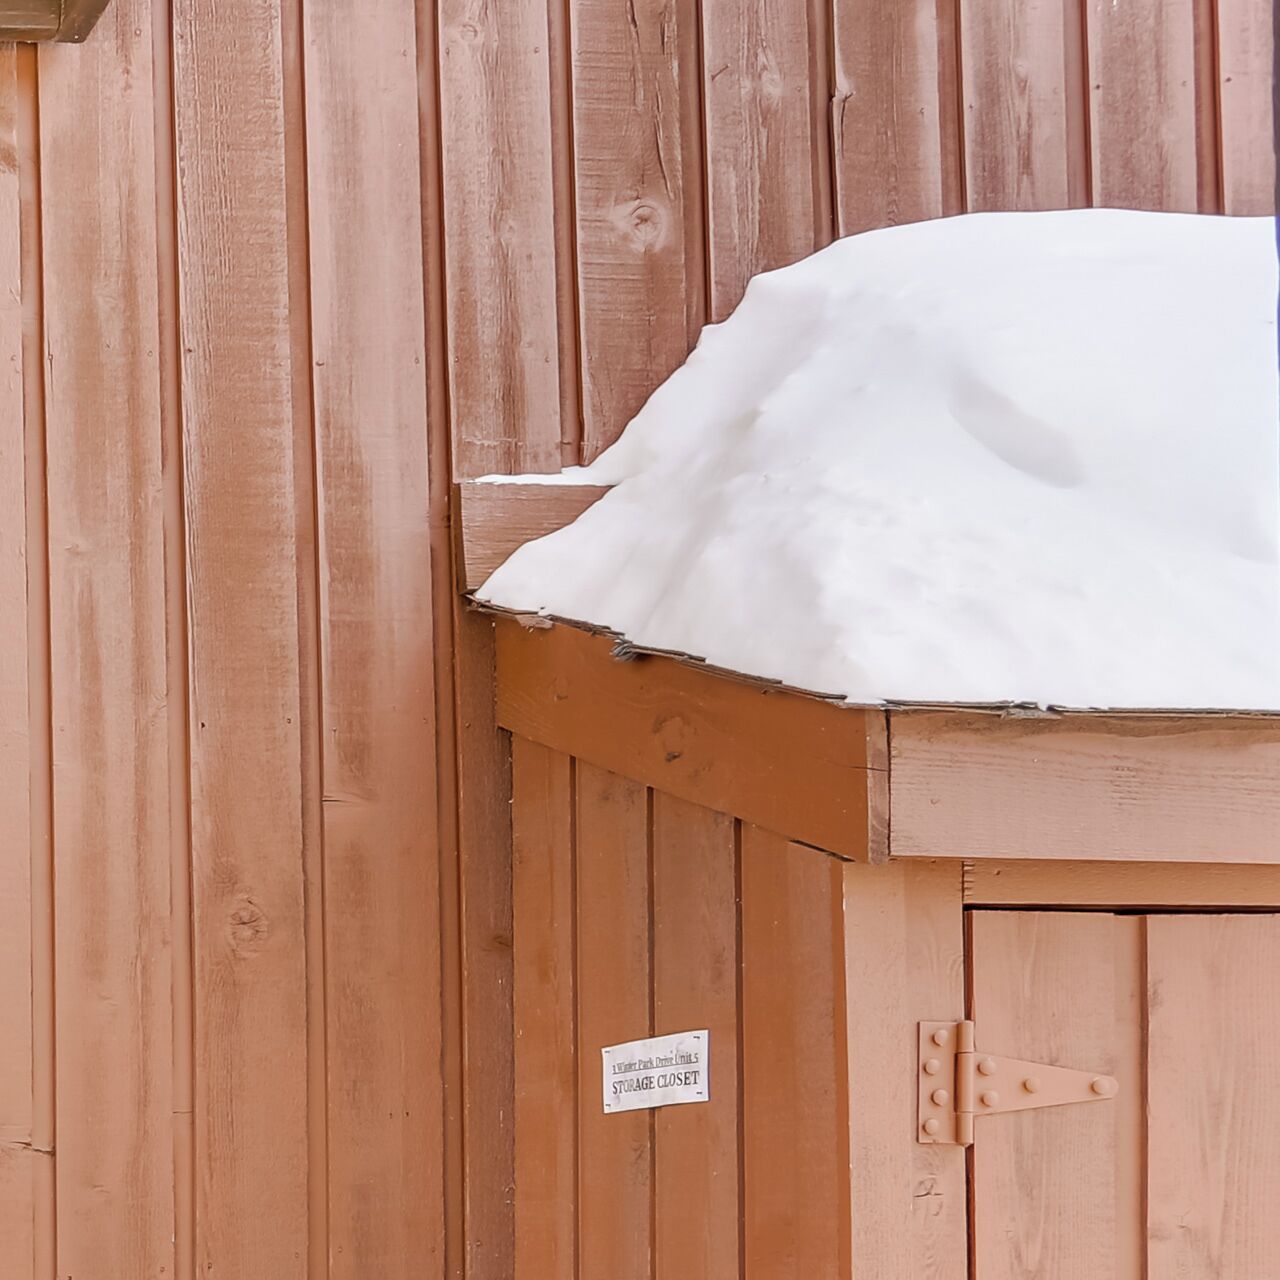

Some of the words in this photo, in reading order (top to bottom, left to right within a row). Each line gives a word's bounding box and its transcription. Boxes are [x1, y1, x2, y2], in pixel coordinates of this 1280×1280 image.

[638, 1057, 654, 1069] Park
[656, 1055, 674, 1067] Drive
[675, 1052, 692, 1065] Unit
[612, 1076, 655, 1095] STORAGE
[657, 1070, 700, 1088] CLOSET
